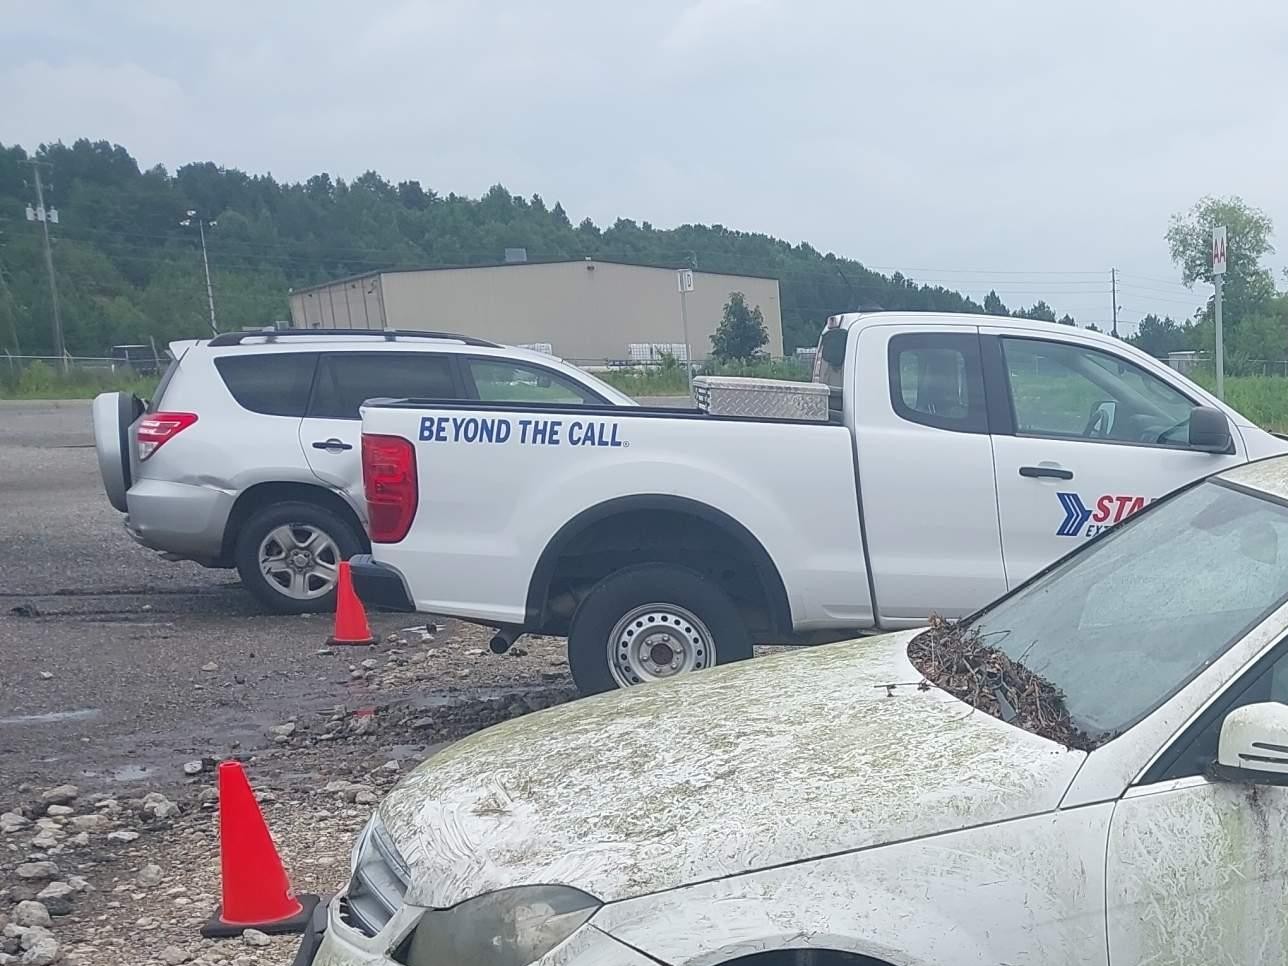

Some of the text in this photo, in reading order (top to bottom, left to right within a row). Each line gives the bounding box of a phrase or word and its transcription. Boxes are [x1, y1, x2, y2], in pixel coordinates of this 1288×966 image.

[418, 416, 511, 443] BEYOND
[518, 420, 563, 445] THE
[1092, 495, 1159, 523] STA
